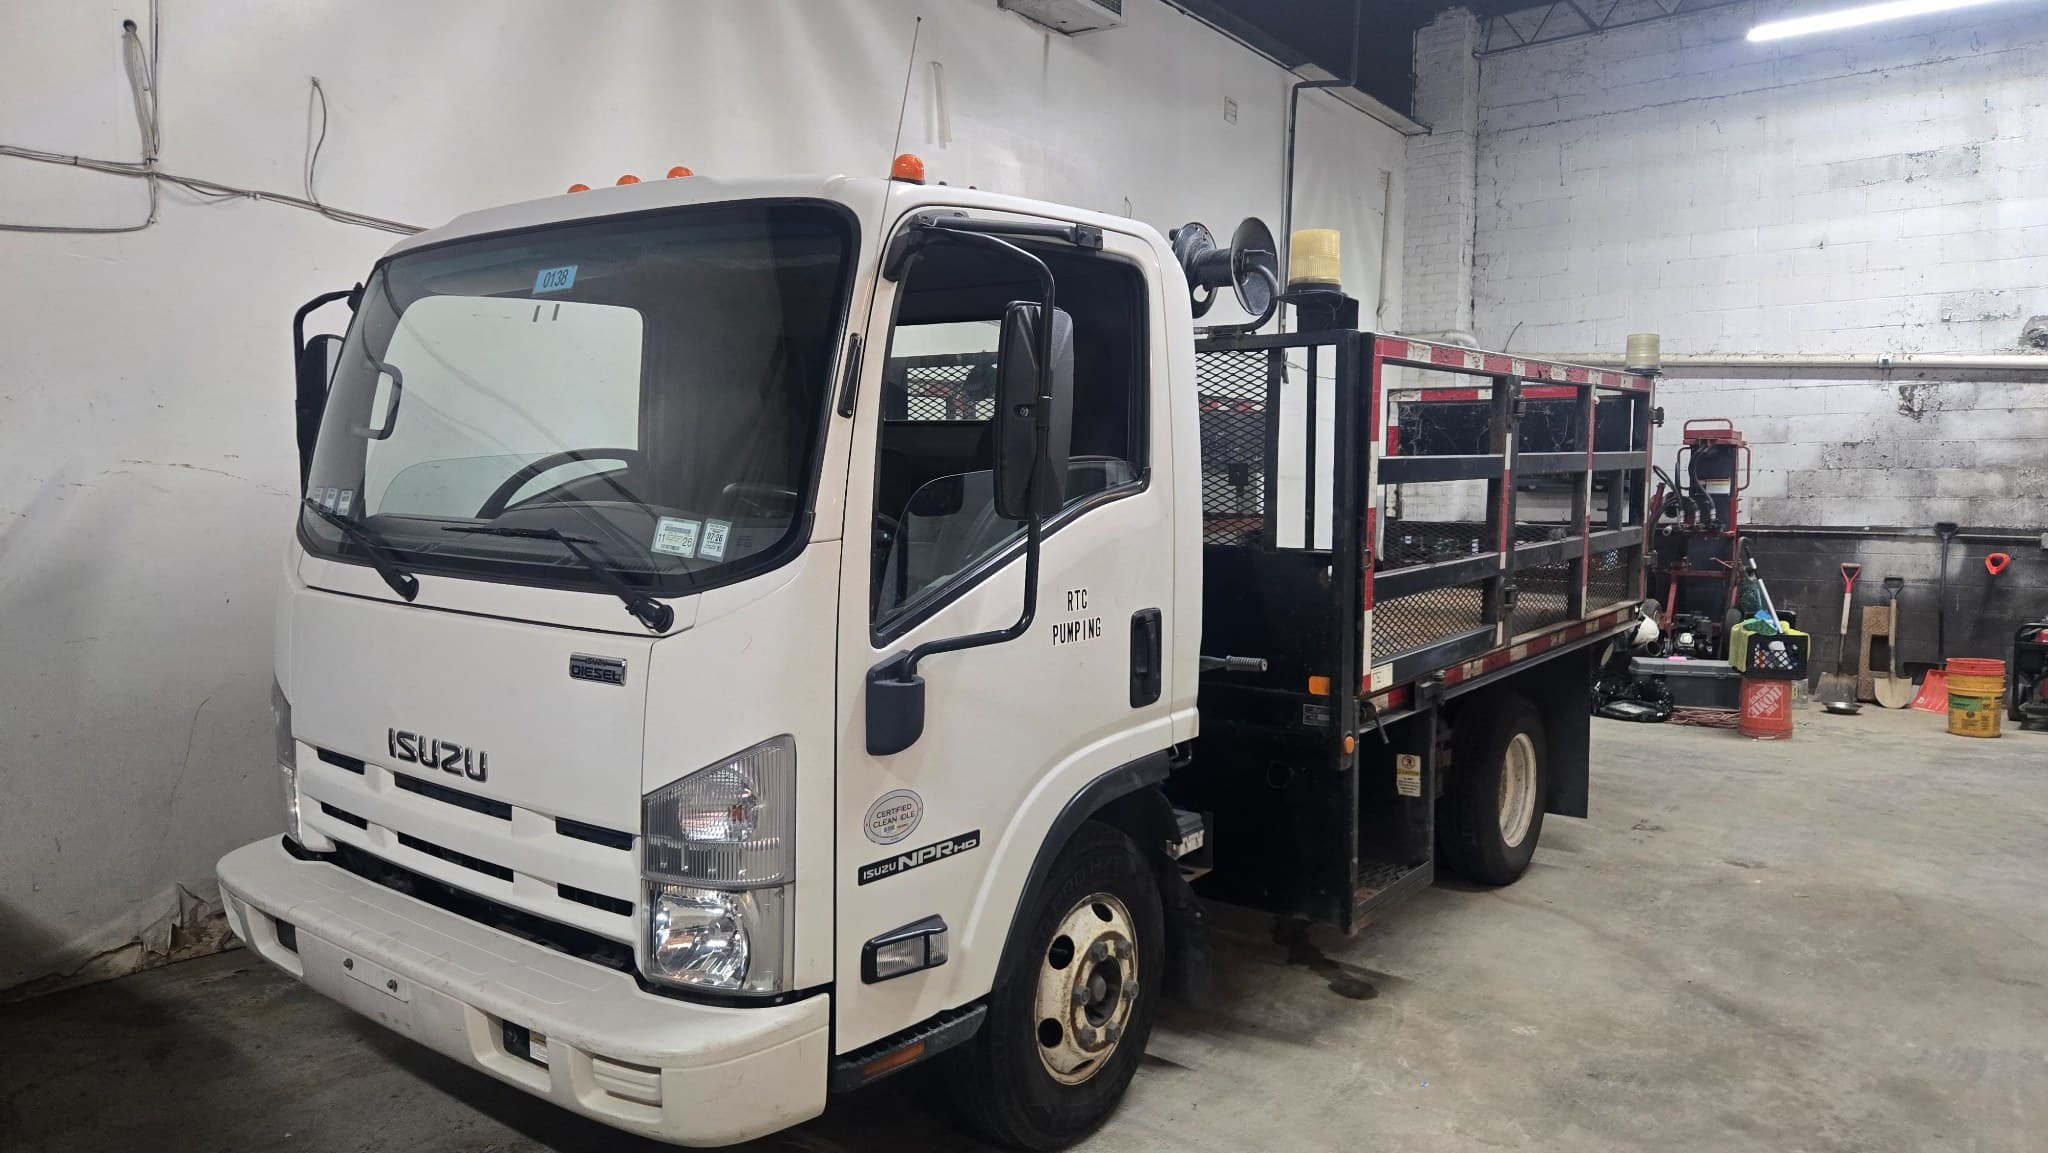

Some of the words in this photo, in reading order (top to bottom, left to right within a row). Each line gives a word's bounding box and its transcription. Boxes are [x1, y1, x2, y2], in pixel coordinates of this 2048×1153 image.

[542, 268, 569, 289] 0138
[682, 536, 693, 547] 26
[1067, 588, 1088, 612] RTC
[1052, 617, 1101, 646] PUMPING
[571, 665, 622, 682] DIESEL
[388, 727, 489, 783] ISUZU
[872, 816, 898, 829] CLEAN
[900, 810, 916, 821] IDLE
[876, 803, 912, 819] CERTIFIED
[863, 862, 897, 880] ISUZU
